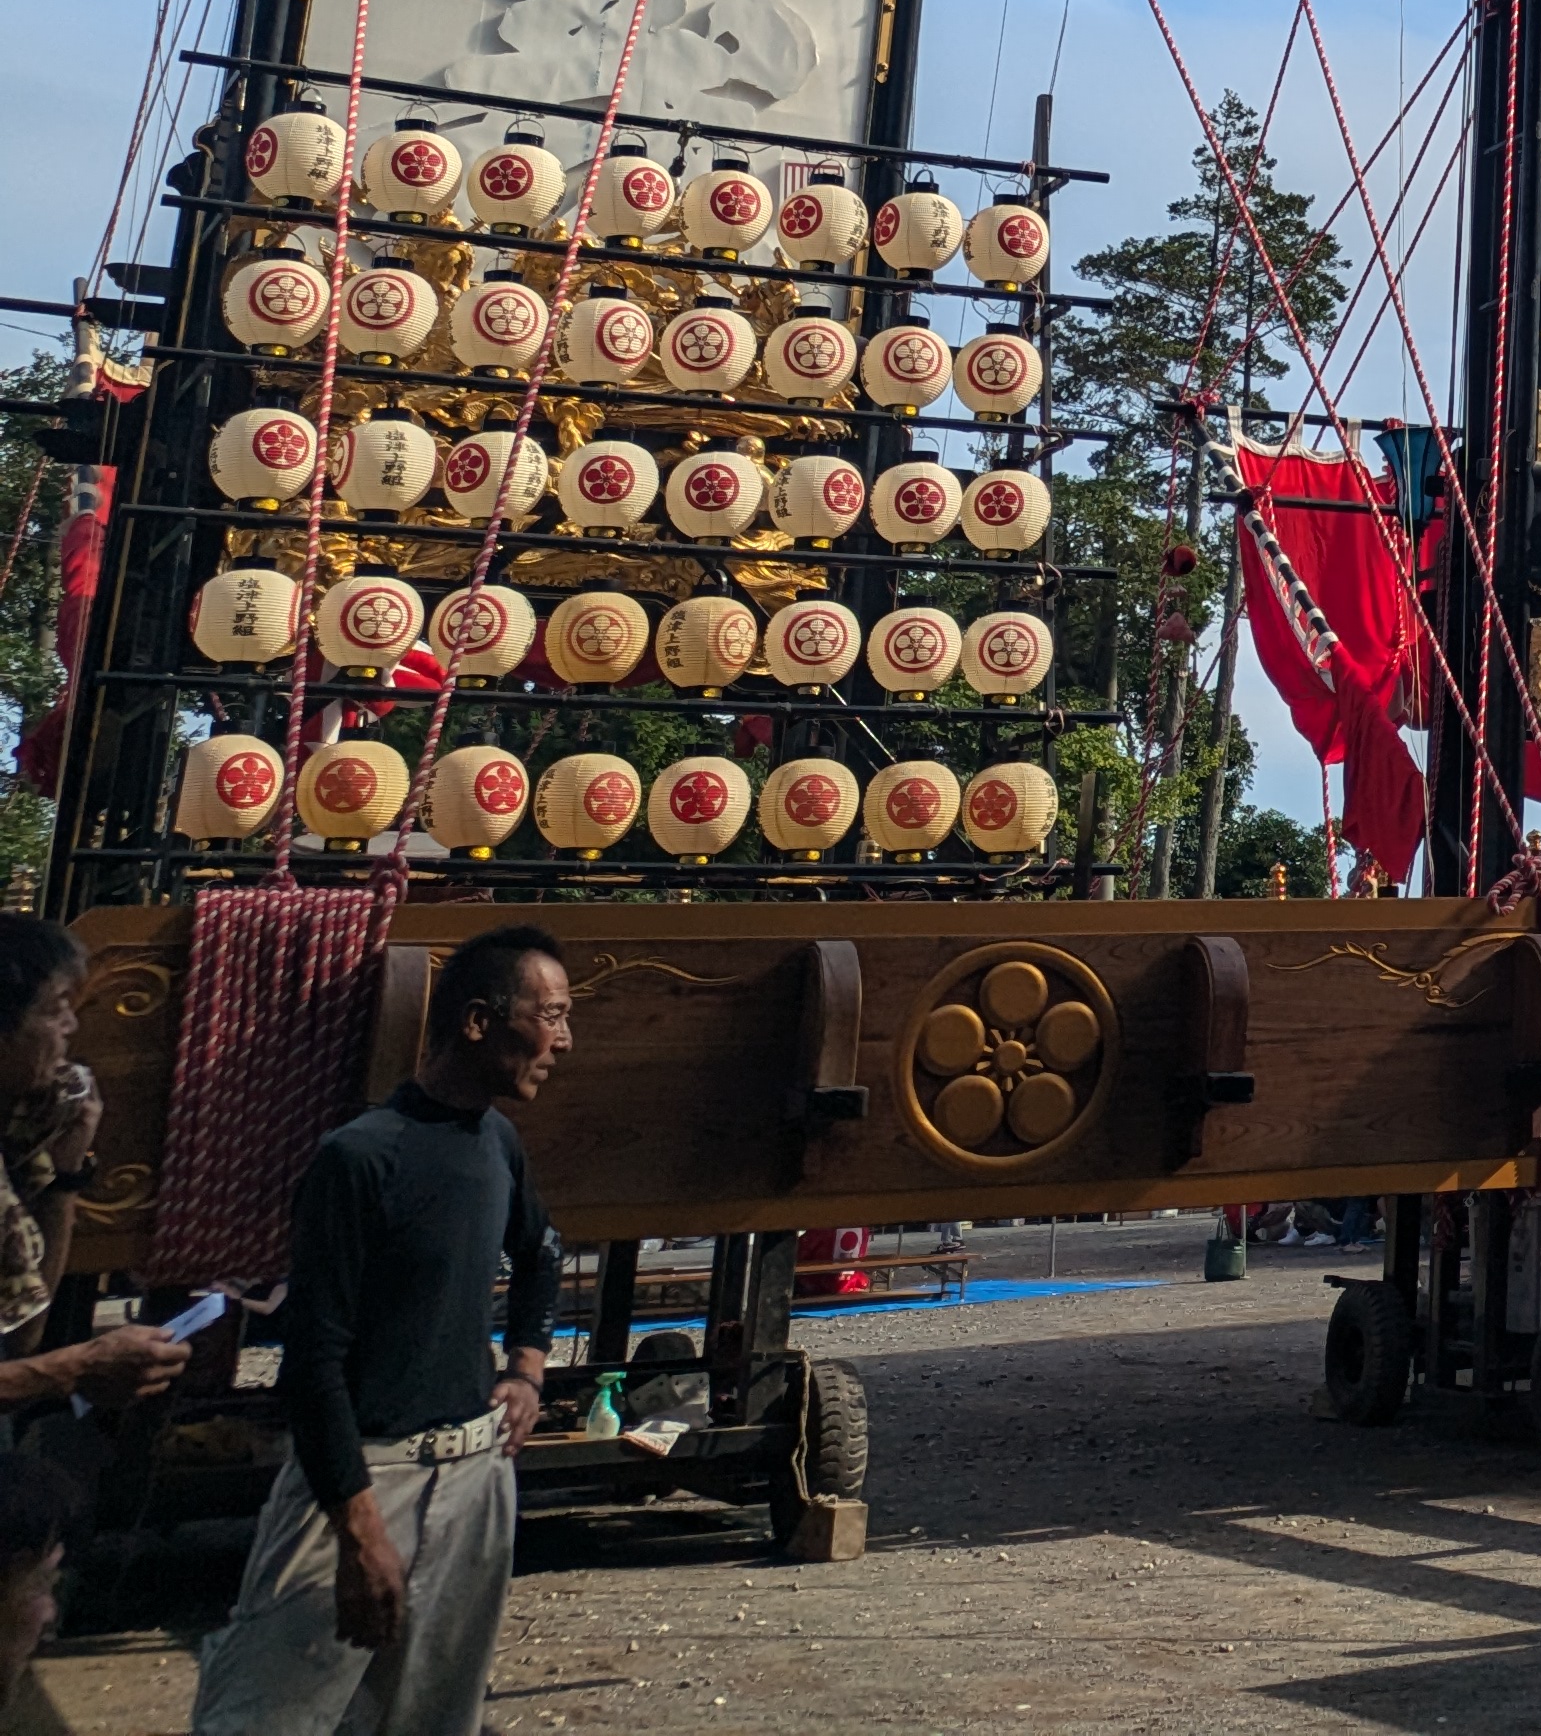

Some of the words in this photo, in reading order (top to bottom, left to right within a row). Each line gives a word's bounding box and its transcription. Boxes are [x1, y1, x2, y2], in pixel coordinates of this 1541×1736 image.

[232, 578, 260, 636] 塩津上野組
